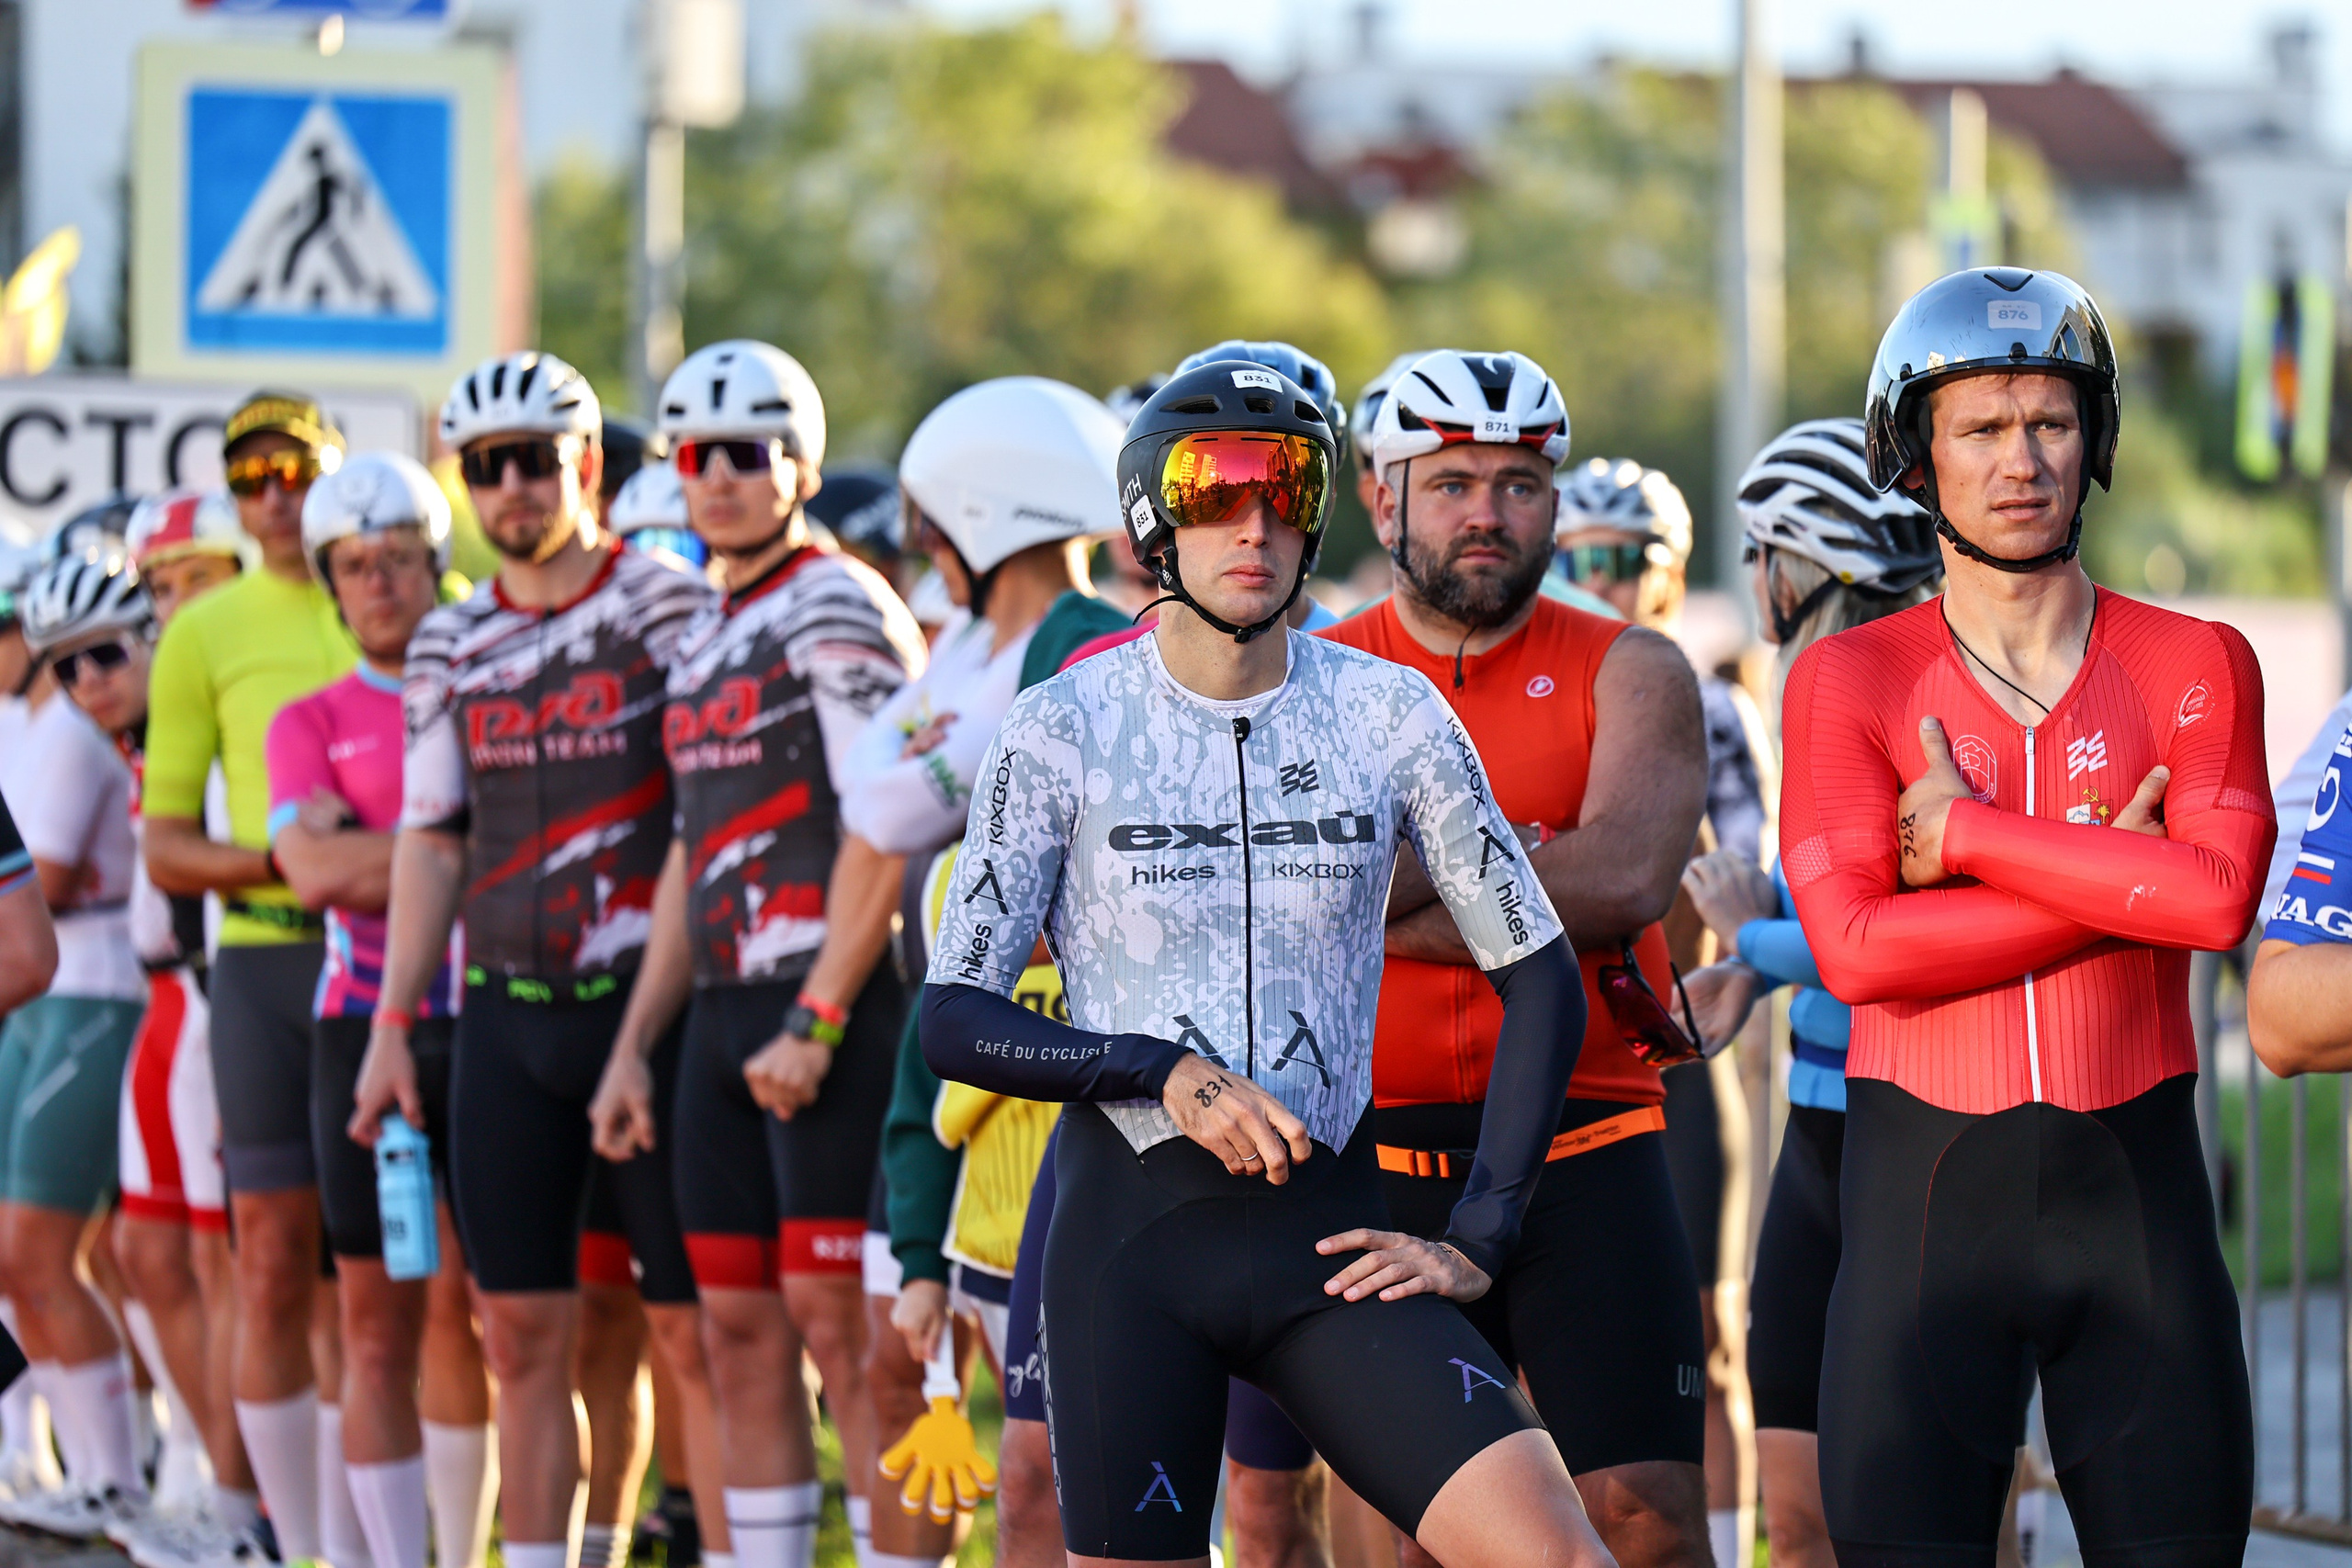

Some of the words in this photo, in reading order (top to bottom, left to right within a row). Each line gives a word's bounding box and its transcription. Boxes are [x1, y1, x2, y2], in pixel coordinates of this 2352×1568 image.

[1997, 310, 2029, 321] 876
[1243, 375, 1272, 384] 831
[1485, 422, 1510, 433] 871
[0, 410, 228, 506] СТО
[1136, 512, 1149, 528] 831
[1447, 716, 1486, 810] KIXBOX
[989, 747, 1017, 845] KIXBOX
[1900, 812, 1917, 858] 876
[1132, 864, 1216, 885] hikes
[1272, 863, 1363, 879] KIXBOX
[1496, 880, 1529, 946] hikes
[957, 923, 991, 981] hikes
[976, 1039, 1011, 1058] CAFÉ
[1014, 1045, 1035, 1060] DU
[1194, 1075, 1233, 1109] 831
